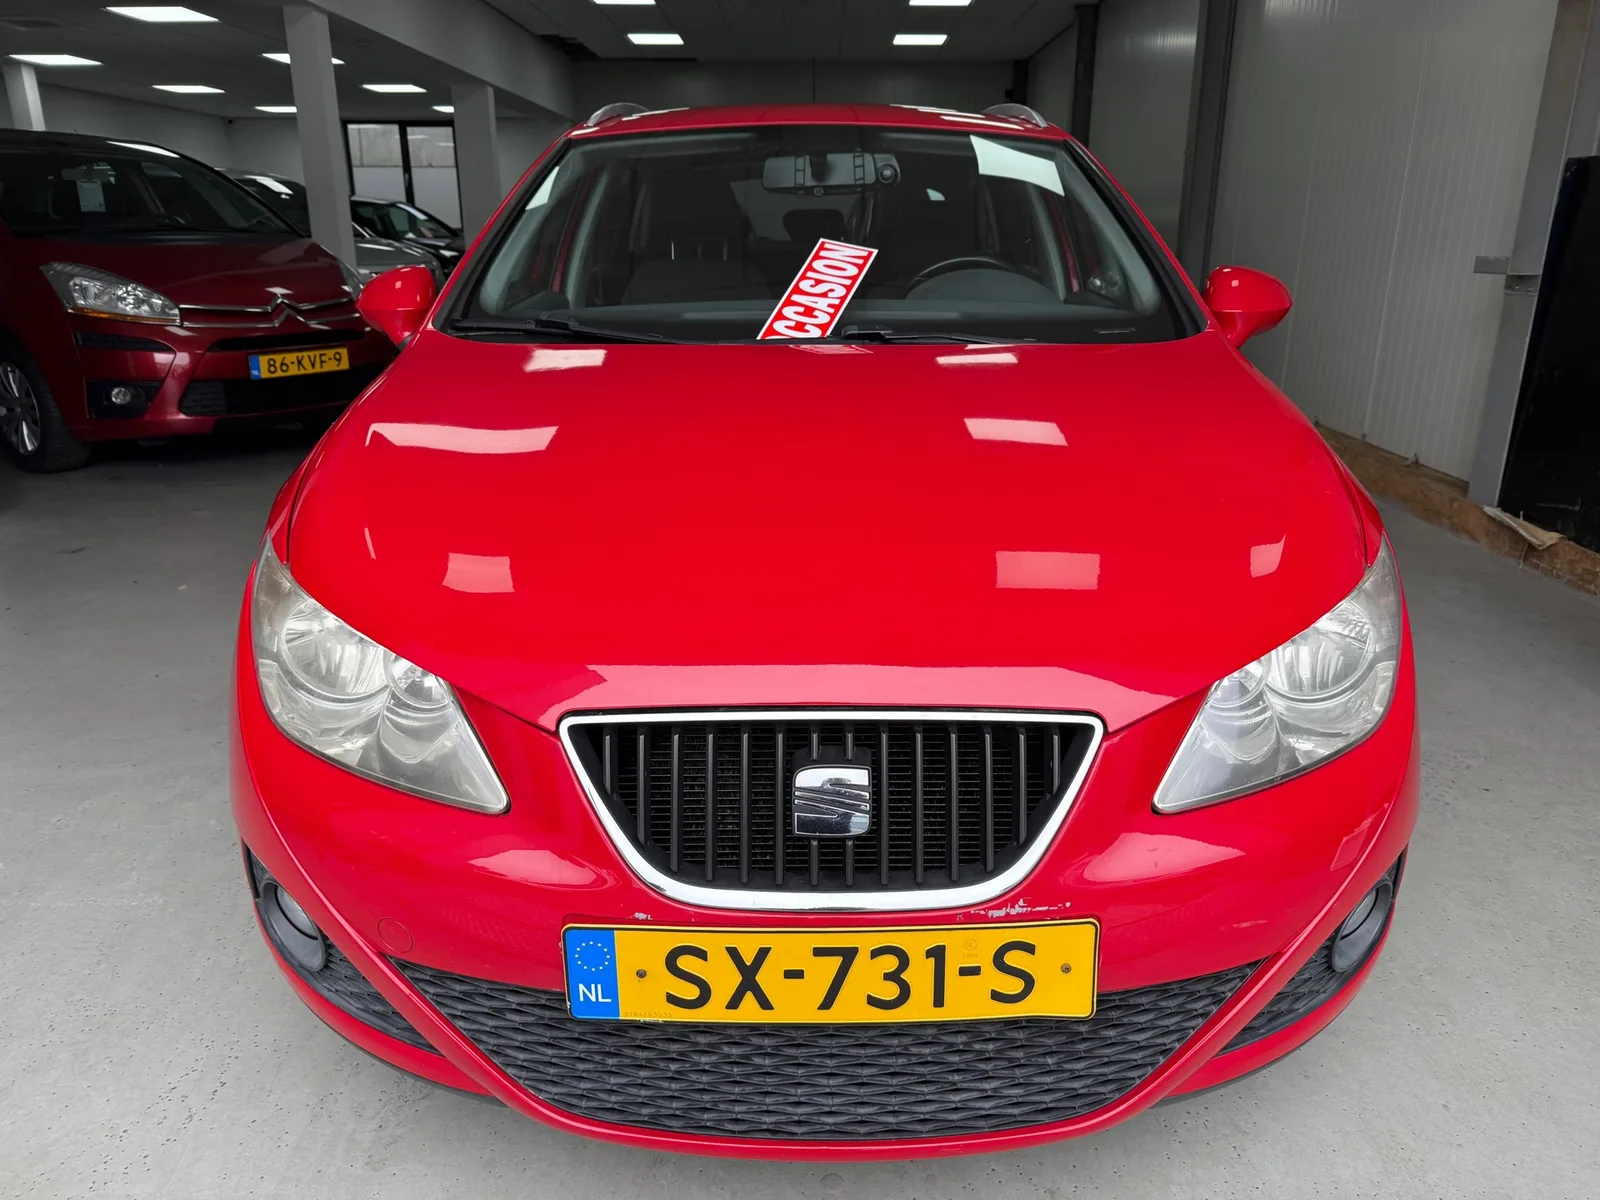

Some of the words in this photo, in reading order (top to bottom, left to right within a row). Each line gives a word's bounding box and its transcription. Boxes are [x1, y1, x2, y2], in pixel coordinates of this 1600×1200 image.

[765, 243, 869, 339] CCASION
[267, 351, 342, 374] 86-KVF-9
[578, 984, 611, 1002] NL
[665, 941, 1036, 1010] SX-731-S
